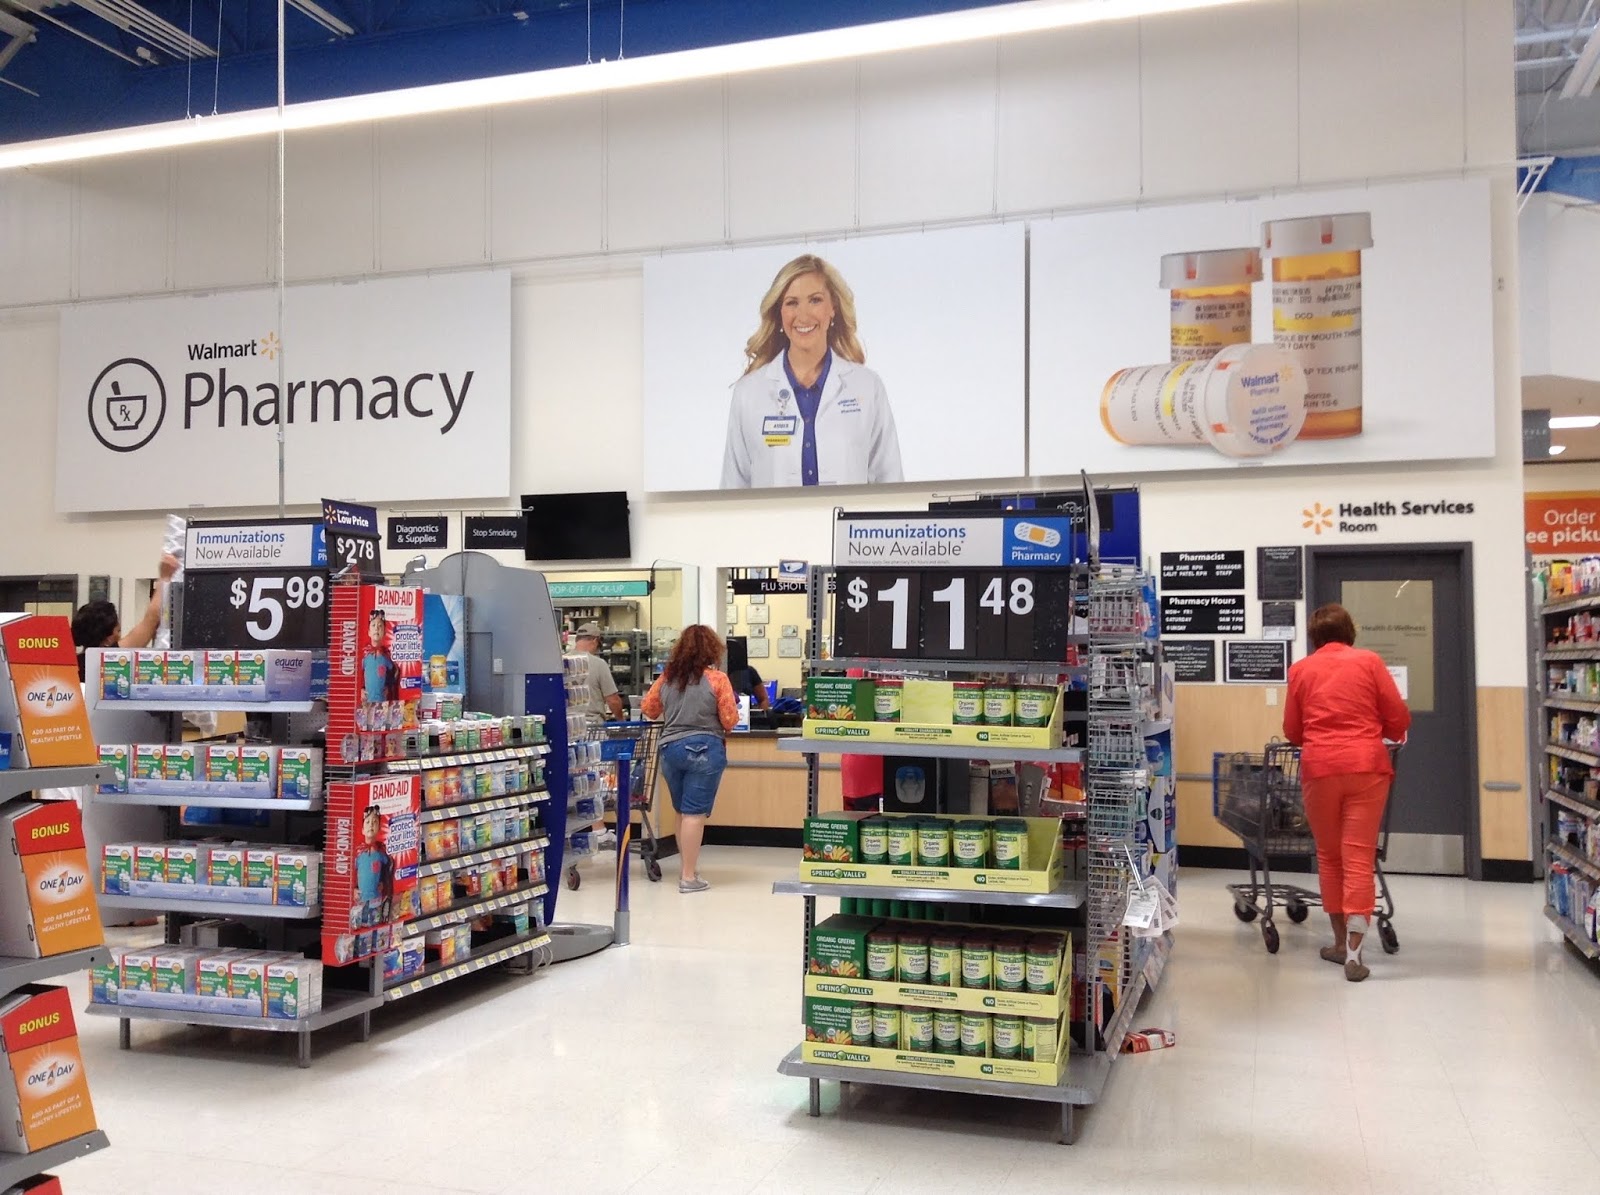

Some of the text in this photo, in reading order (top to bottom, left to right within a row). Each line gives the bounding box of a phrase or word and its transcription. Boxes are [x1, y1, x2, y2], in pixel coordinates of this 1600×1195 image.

[1312, 332, 1342, 341] MOUTH
[188, 339, 257, 360] Walmart
[1241, 373, 1279, 387] Walmart
[183, 367, 474, 435] Pharmacy
[1339, 500, 1474, 517] Health Services
[337, 514, 369, 527] Low Price
[1544, 508, 1596, 525] Order
[396, 524, 439, 535] Diagnostics
[473, 529, 517, 538] Stop Smoking
[849, 523, 966, 539] Immunizations
[1339, 522, 1377, 533] Room
[196, 530, 285, 544] Immunizations
[398, 534, 436, 544] & Supplies
[1526, 526, 1600, 547] ee picku
[196, 547, 223, 559] Now
[849, 541, 884, 556] Now
[1012, 551, 1061, 562] Pharmacy
[1179, 553, 1225, 561] Pharmacist
[550, 585, 584, 594] ROP-OFF
[592, 585, 624, 593] PICK-UP
[761, 582, 776, 591] FLU
[378, 590, 413, 606] BAND-AID
[1169, 597, 1210, 606] Pharmacy
[19, 638, 58, 648] BONUS
[396, 632, 418, 641] protect
[342, 621, 356, 675] BAND-AID
[407, 641, 420, 650] little
[392, 651, 420, 660] character
[275, 658, 303, 667] equate
[28, 692, 45, 702] ONE
[56, 692, 74, 702] DAY
[56, 734, 82, 742] LIFESTYLE
[372, 780, 409, 800] BAND-AID
[32, 823, 70, 839] BONUS
[391, 820, 413, 832] protect
[387, 830, 416, 845] your little
[335, 818, 350, 875] BAND-AID
[387, 840, 416, 853] character
[40, 878, 58, 890] ONE
[67, 875, 84, 887] DAY
[65, 914, 91, 927] LIFESTYLE
[19, 1012, 60, 1035] BONUS
[28, 1072, 47, 1086] ONE
[56, 1063, 74, 1077] DAY
[52, 1101, 66, 1111] PART
[55, 1102, 82, 1119] LIFESTYLE
